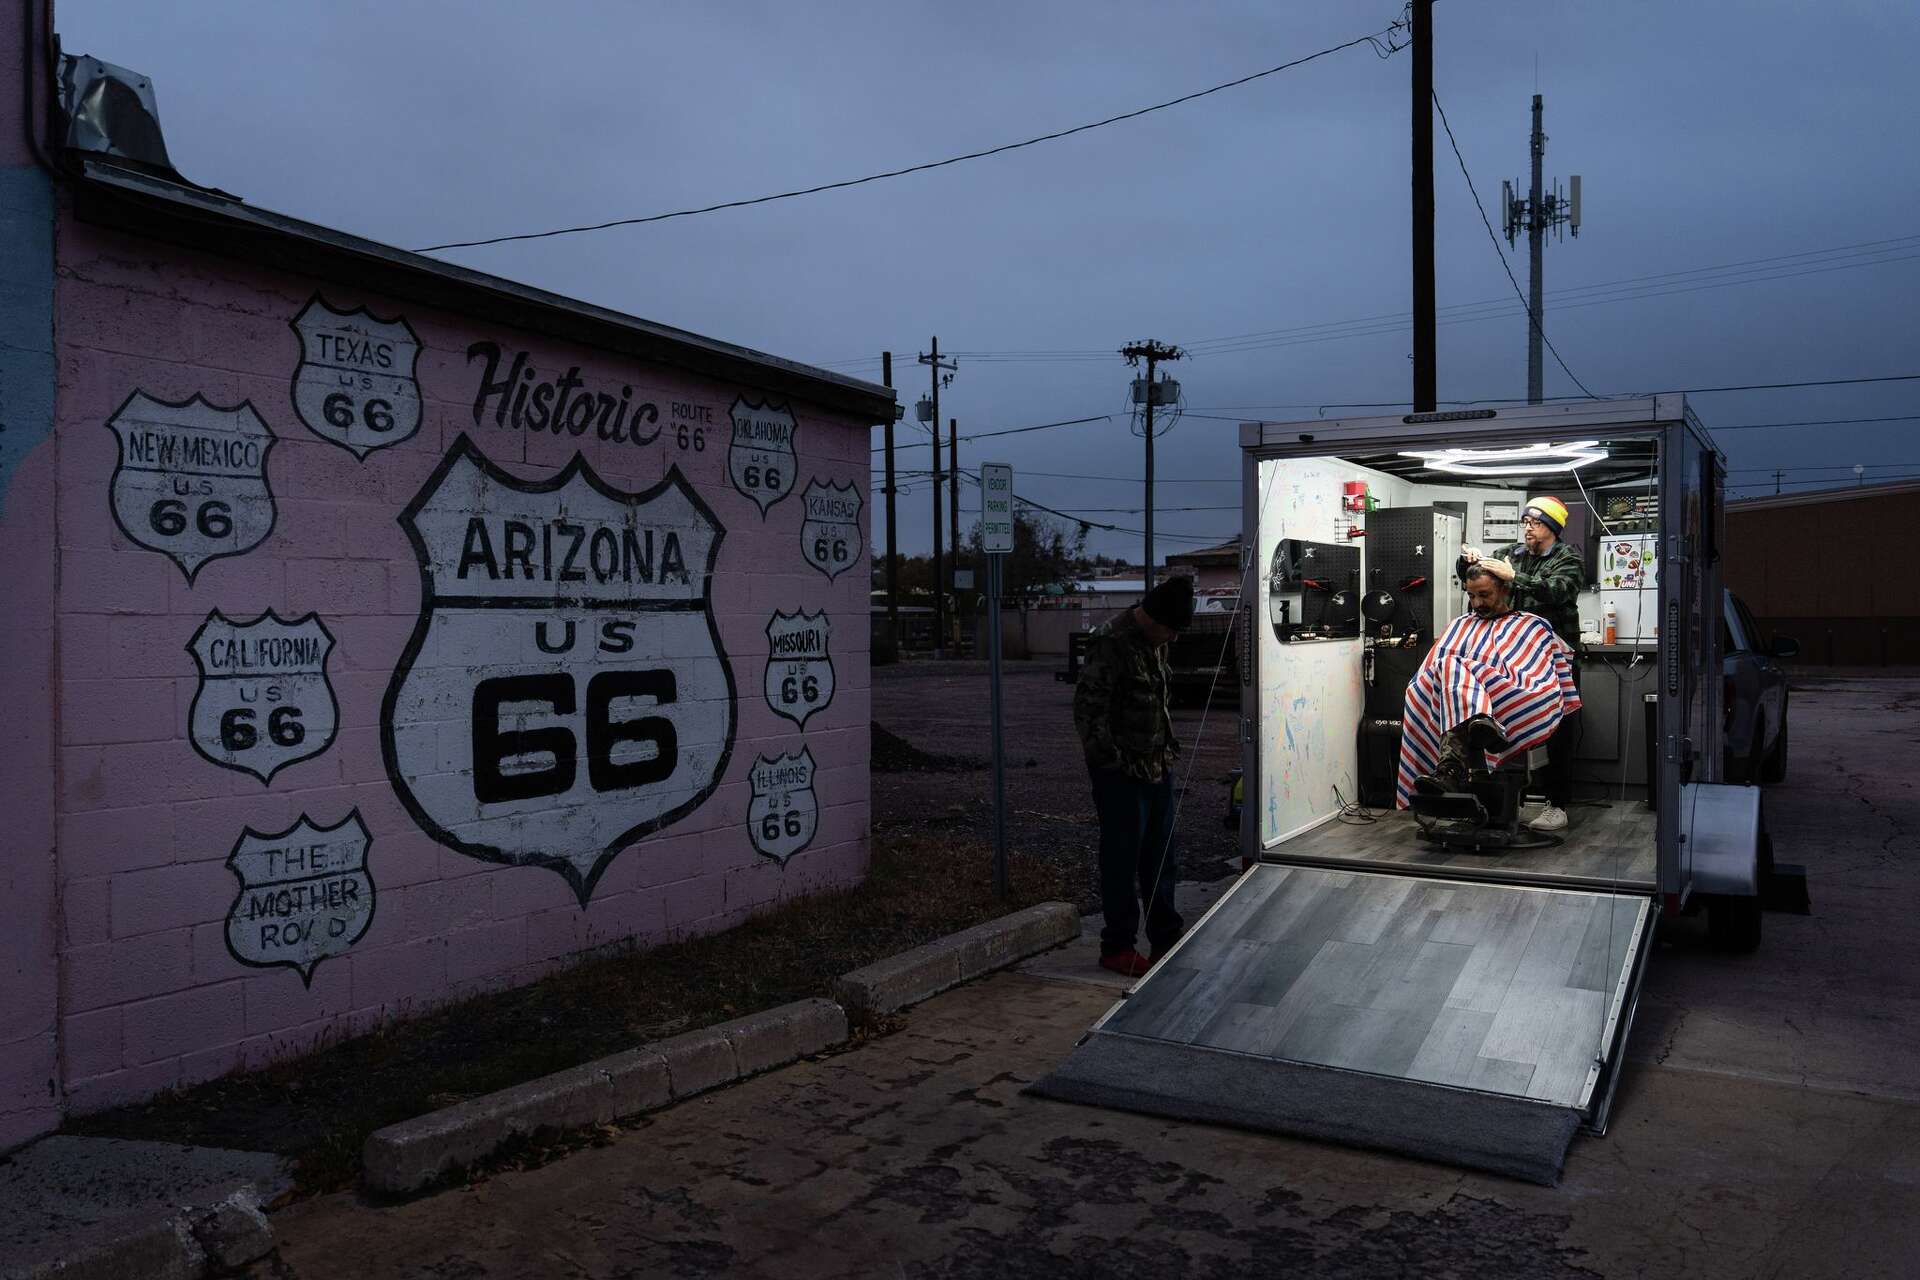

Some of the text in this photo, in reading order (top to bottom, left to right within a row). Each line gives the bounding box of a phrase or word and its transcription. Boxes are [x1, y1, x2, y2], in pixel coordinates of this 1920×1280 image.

[316, 333, 393, 368] TEXAS
[339, 375, 373, 390] US
[467, 341, 662, 446] Historic
[323, 393, 395, 433] 66
[672, 401, 712, 424] ROUTE
[735, 417, 789, 445] OKLAHOMA
[129, 431, 259, 469] NEW MEXICO
[173, 479, 213, 496] US
[743, 466, 781, 490] 66
[150, 500, 233, 538] 66
[809, 498, 854, 518] KANSAS
[457, 517, 690, 585] ARIZONA
[814, 538, 848, 563] 66
[535, 620, 637, 654] US
[773, 629, 820, 654] MISSOURI
[210, 638, 321, 668] CALIFORNIA
[240, 686, 282, 703] US
[781, 675, 818, 704] 66
[220, 706, 305, 751] 66
[472, 669, 678, 804] 66
[757, 766, 807, 788] ILLINOIS
[762, 810, 801, 840] 66
[249, 878, 359, 921] MOTHER
